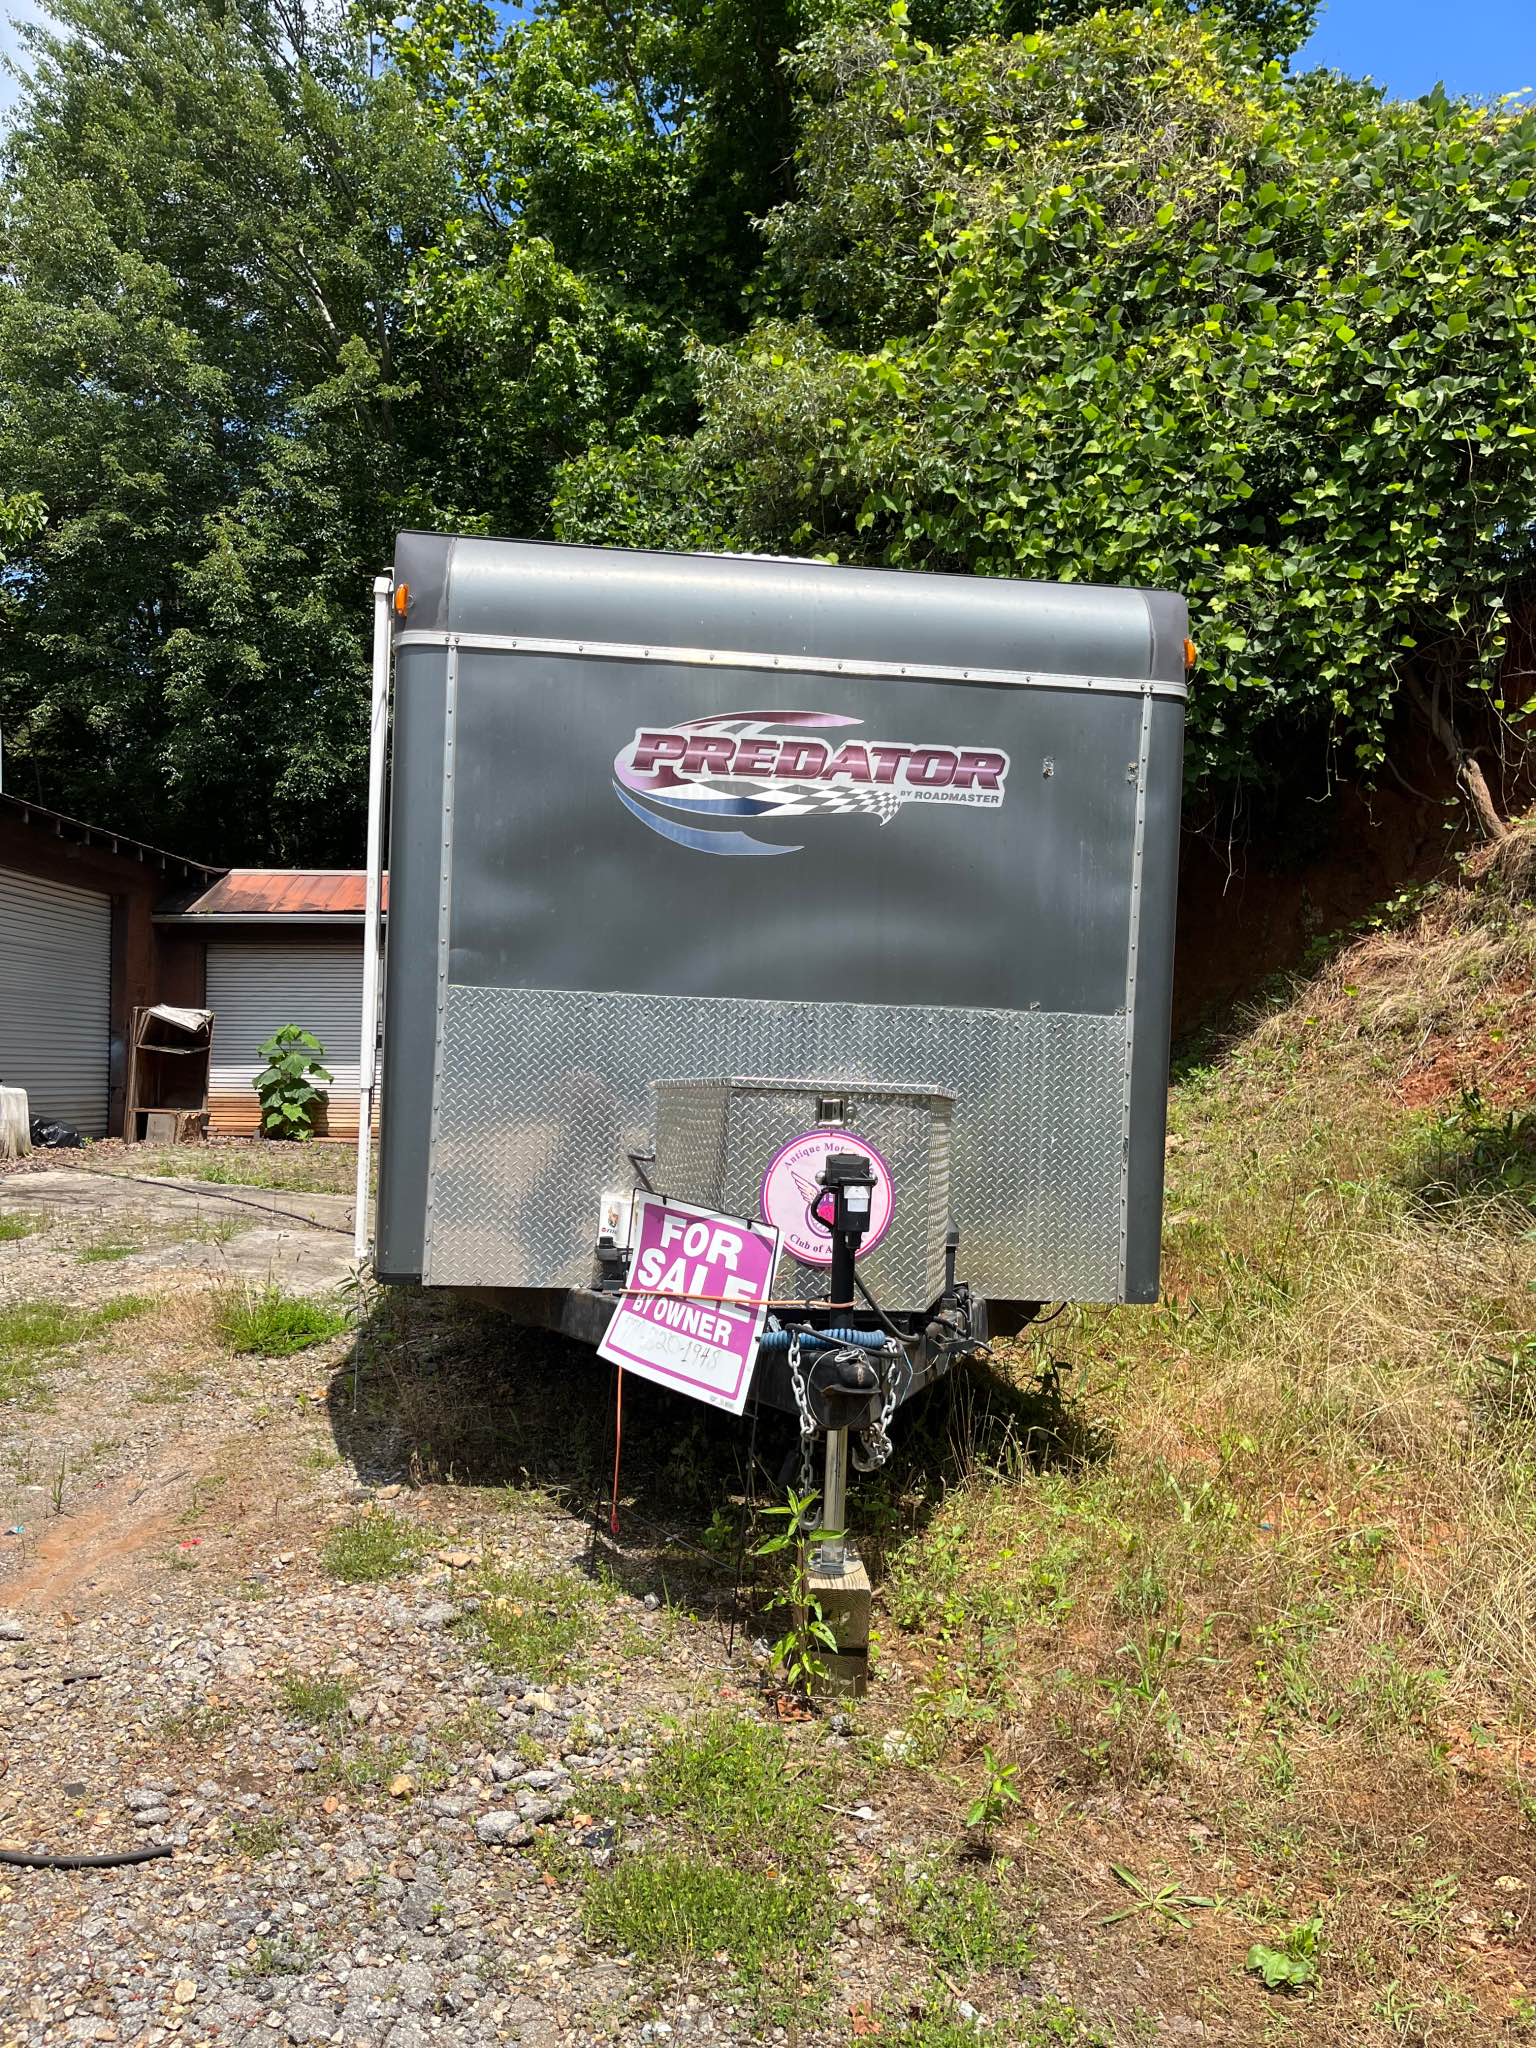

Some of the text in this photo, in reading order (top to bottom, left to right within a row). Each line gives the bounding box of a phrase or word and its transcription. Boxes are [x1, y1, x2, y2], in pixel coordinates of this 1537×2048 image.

[631, 733, 1005, 790] PREDATOR
[914, 790, 1000, 804] ROADMASTER
[784, 1146, 821, 1170] Antique
[660, 1213, 743, 1272] FOR
[790, 1233, 811, 1250] Club
[812, 1244, 824, 1253] of
[638, 1247, 758, 1324] SALE
[632, 1288, 733, 1347] BY OWNER
